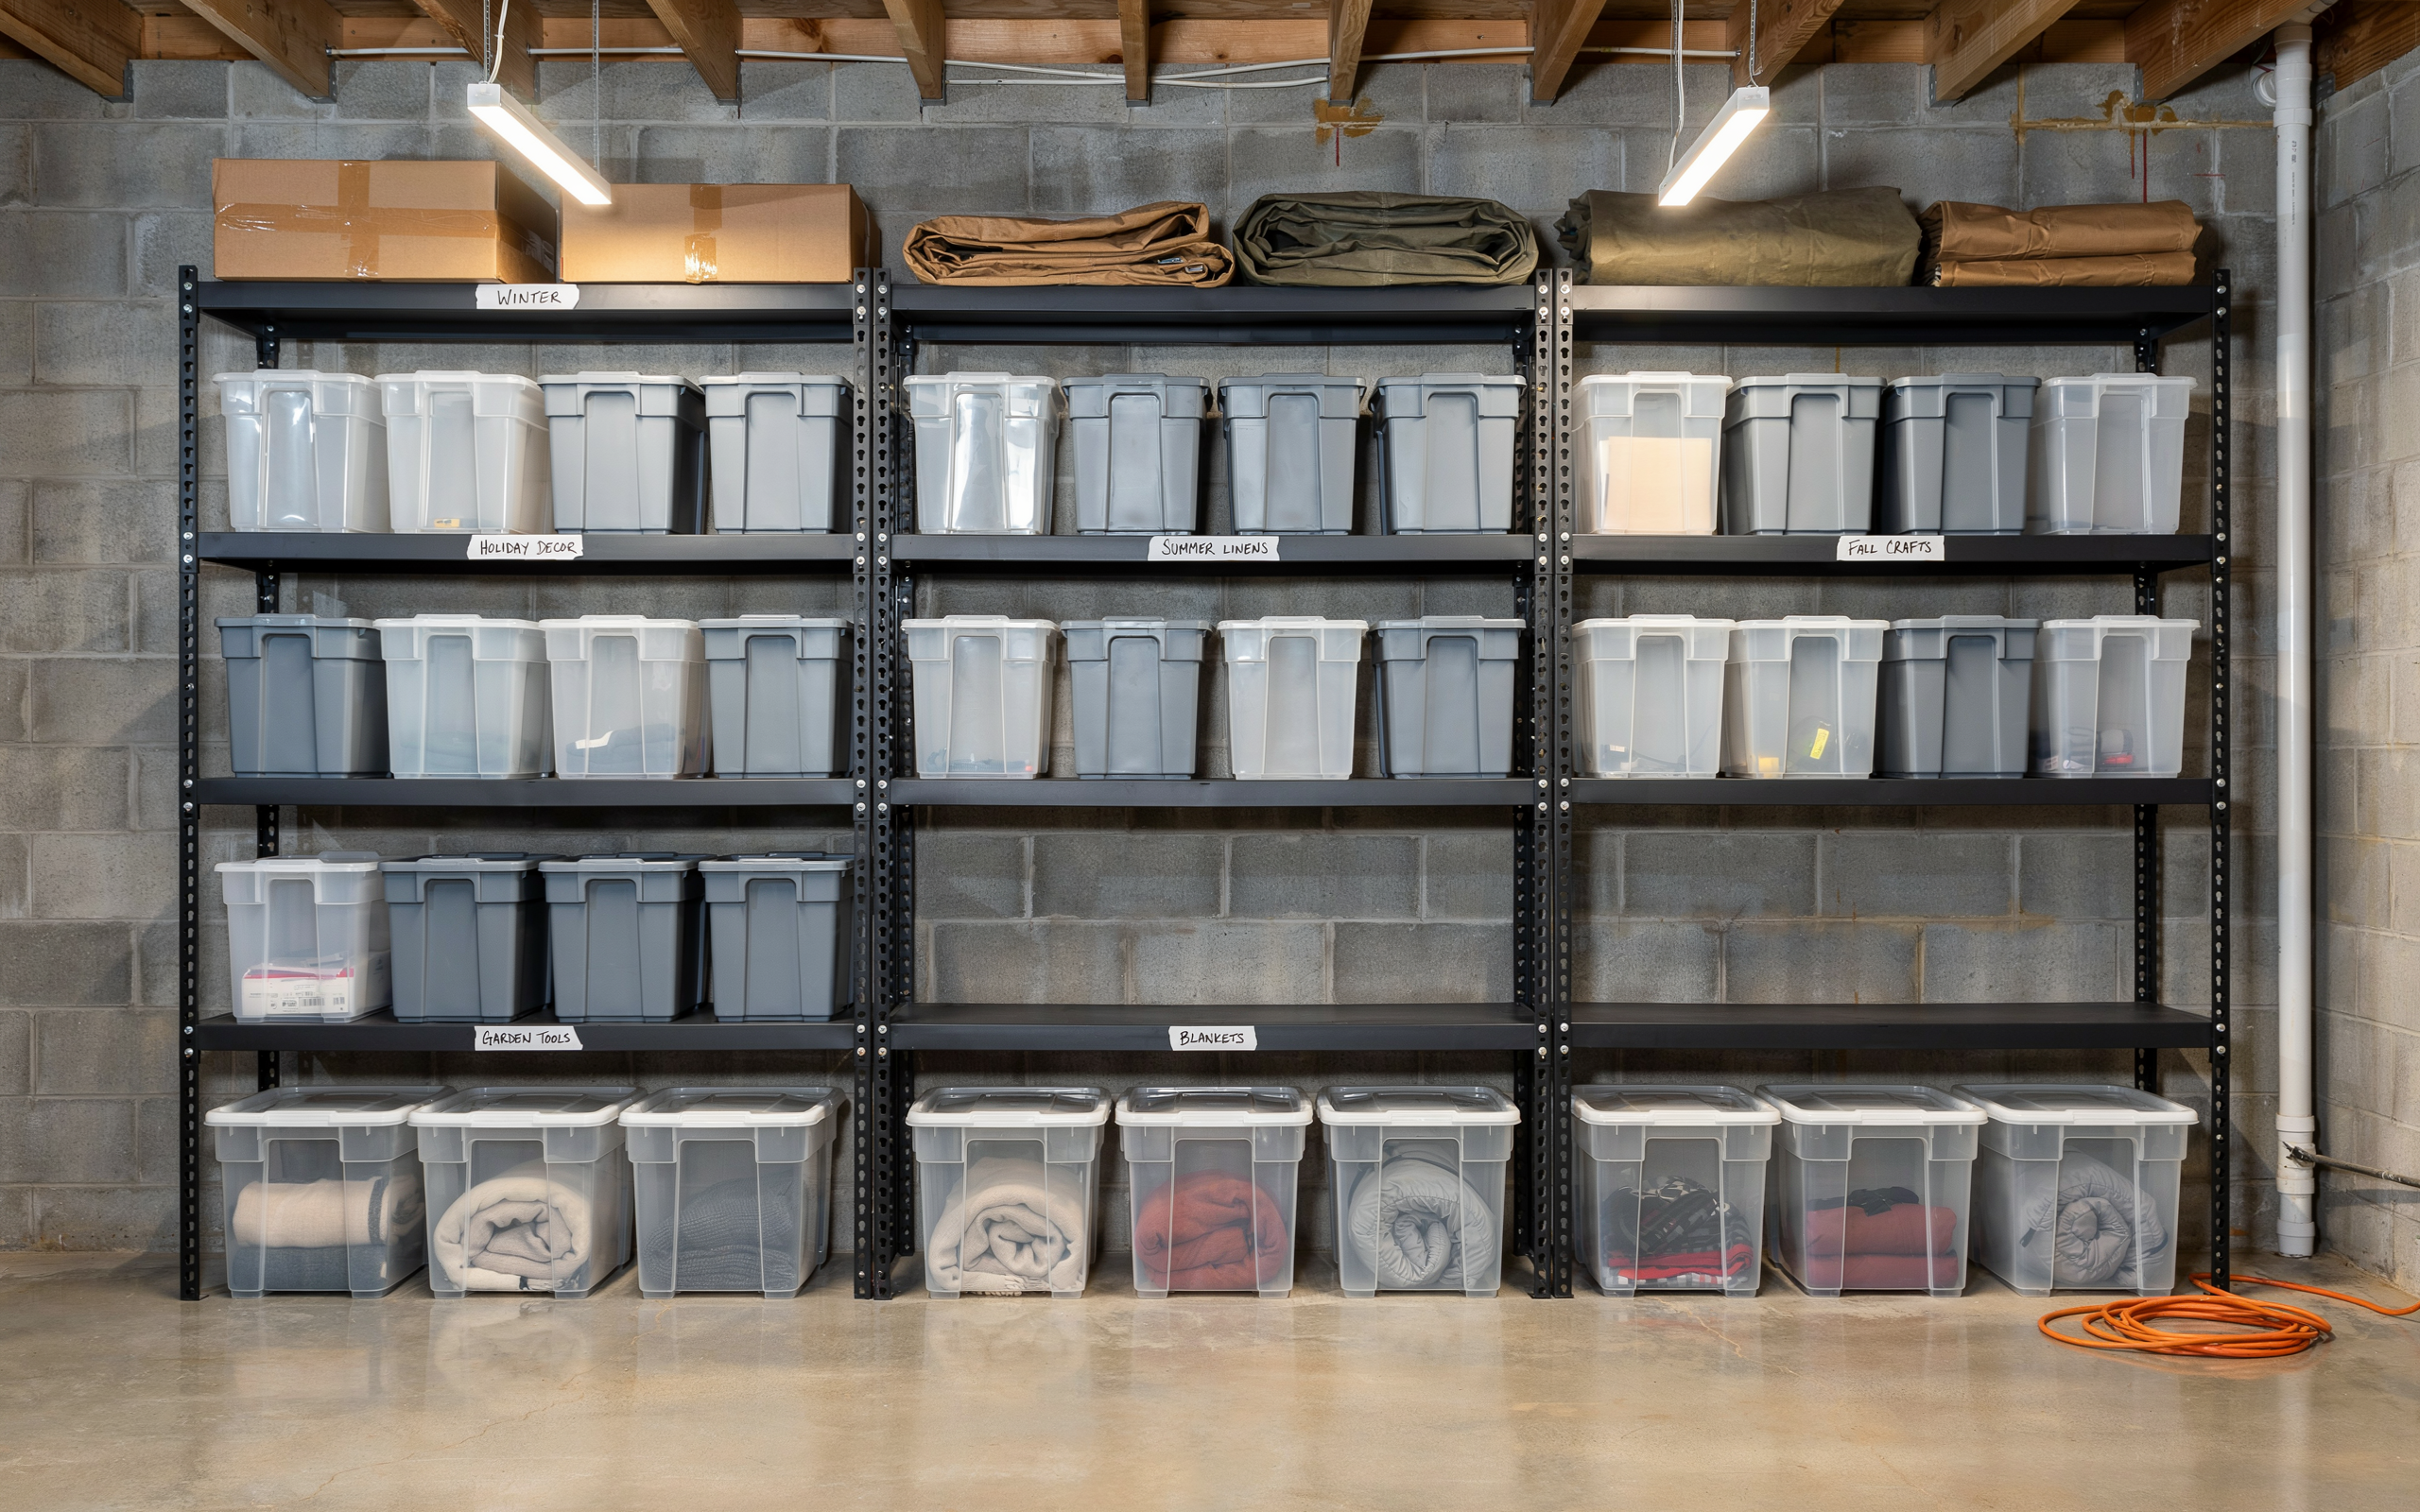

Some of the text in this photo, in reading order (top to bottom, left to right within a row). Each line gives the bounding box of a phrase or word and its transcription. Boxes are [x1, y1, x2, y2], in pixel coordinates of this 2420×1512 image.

[497, 289, 562, 305] WINTER
[480, 540, 578, 556] HOLIDAY DECOR
[1161, 539, 1269, 556] SUMMER LINENS
[1848, 539, 1932, 556] FALL CRAFTS
[482, 1030, 571, 1046] GARDEN TOOLS
[1180, 1030, 1245, 1046] BLANKETS
